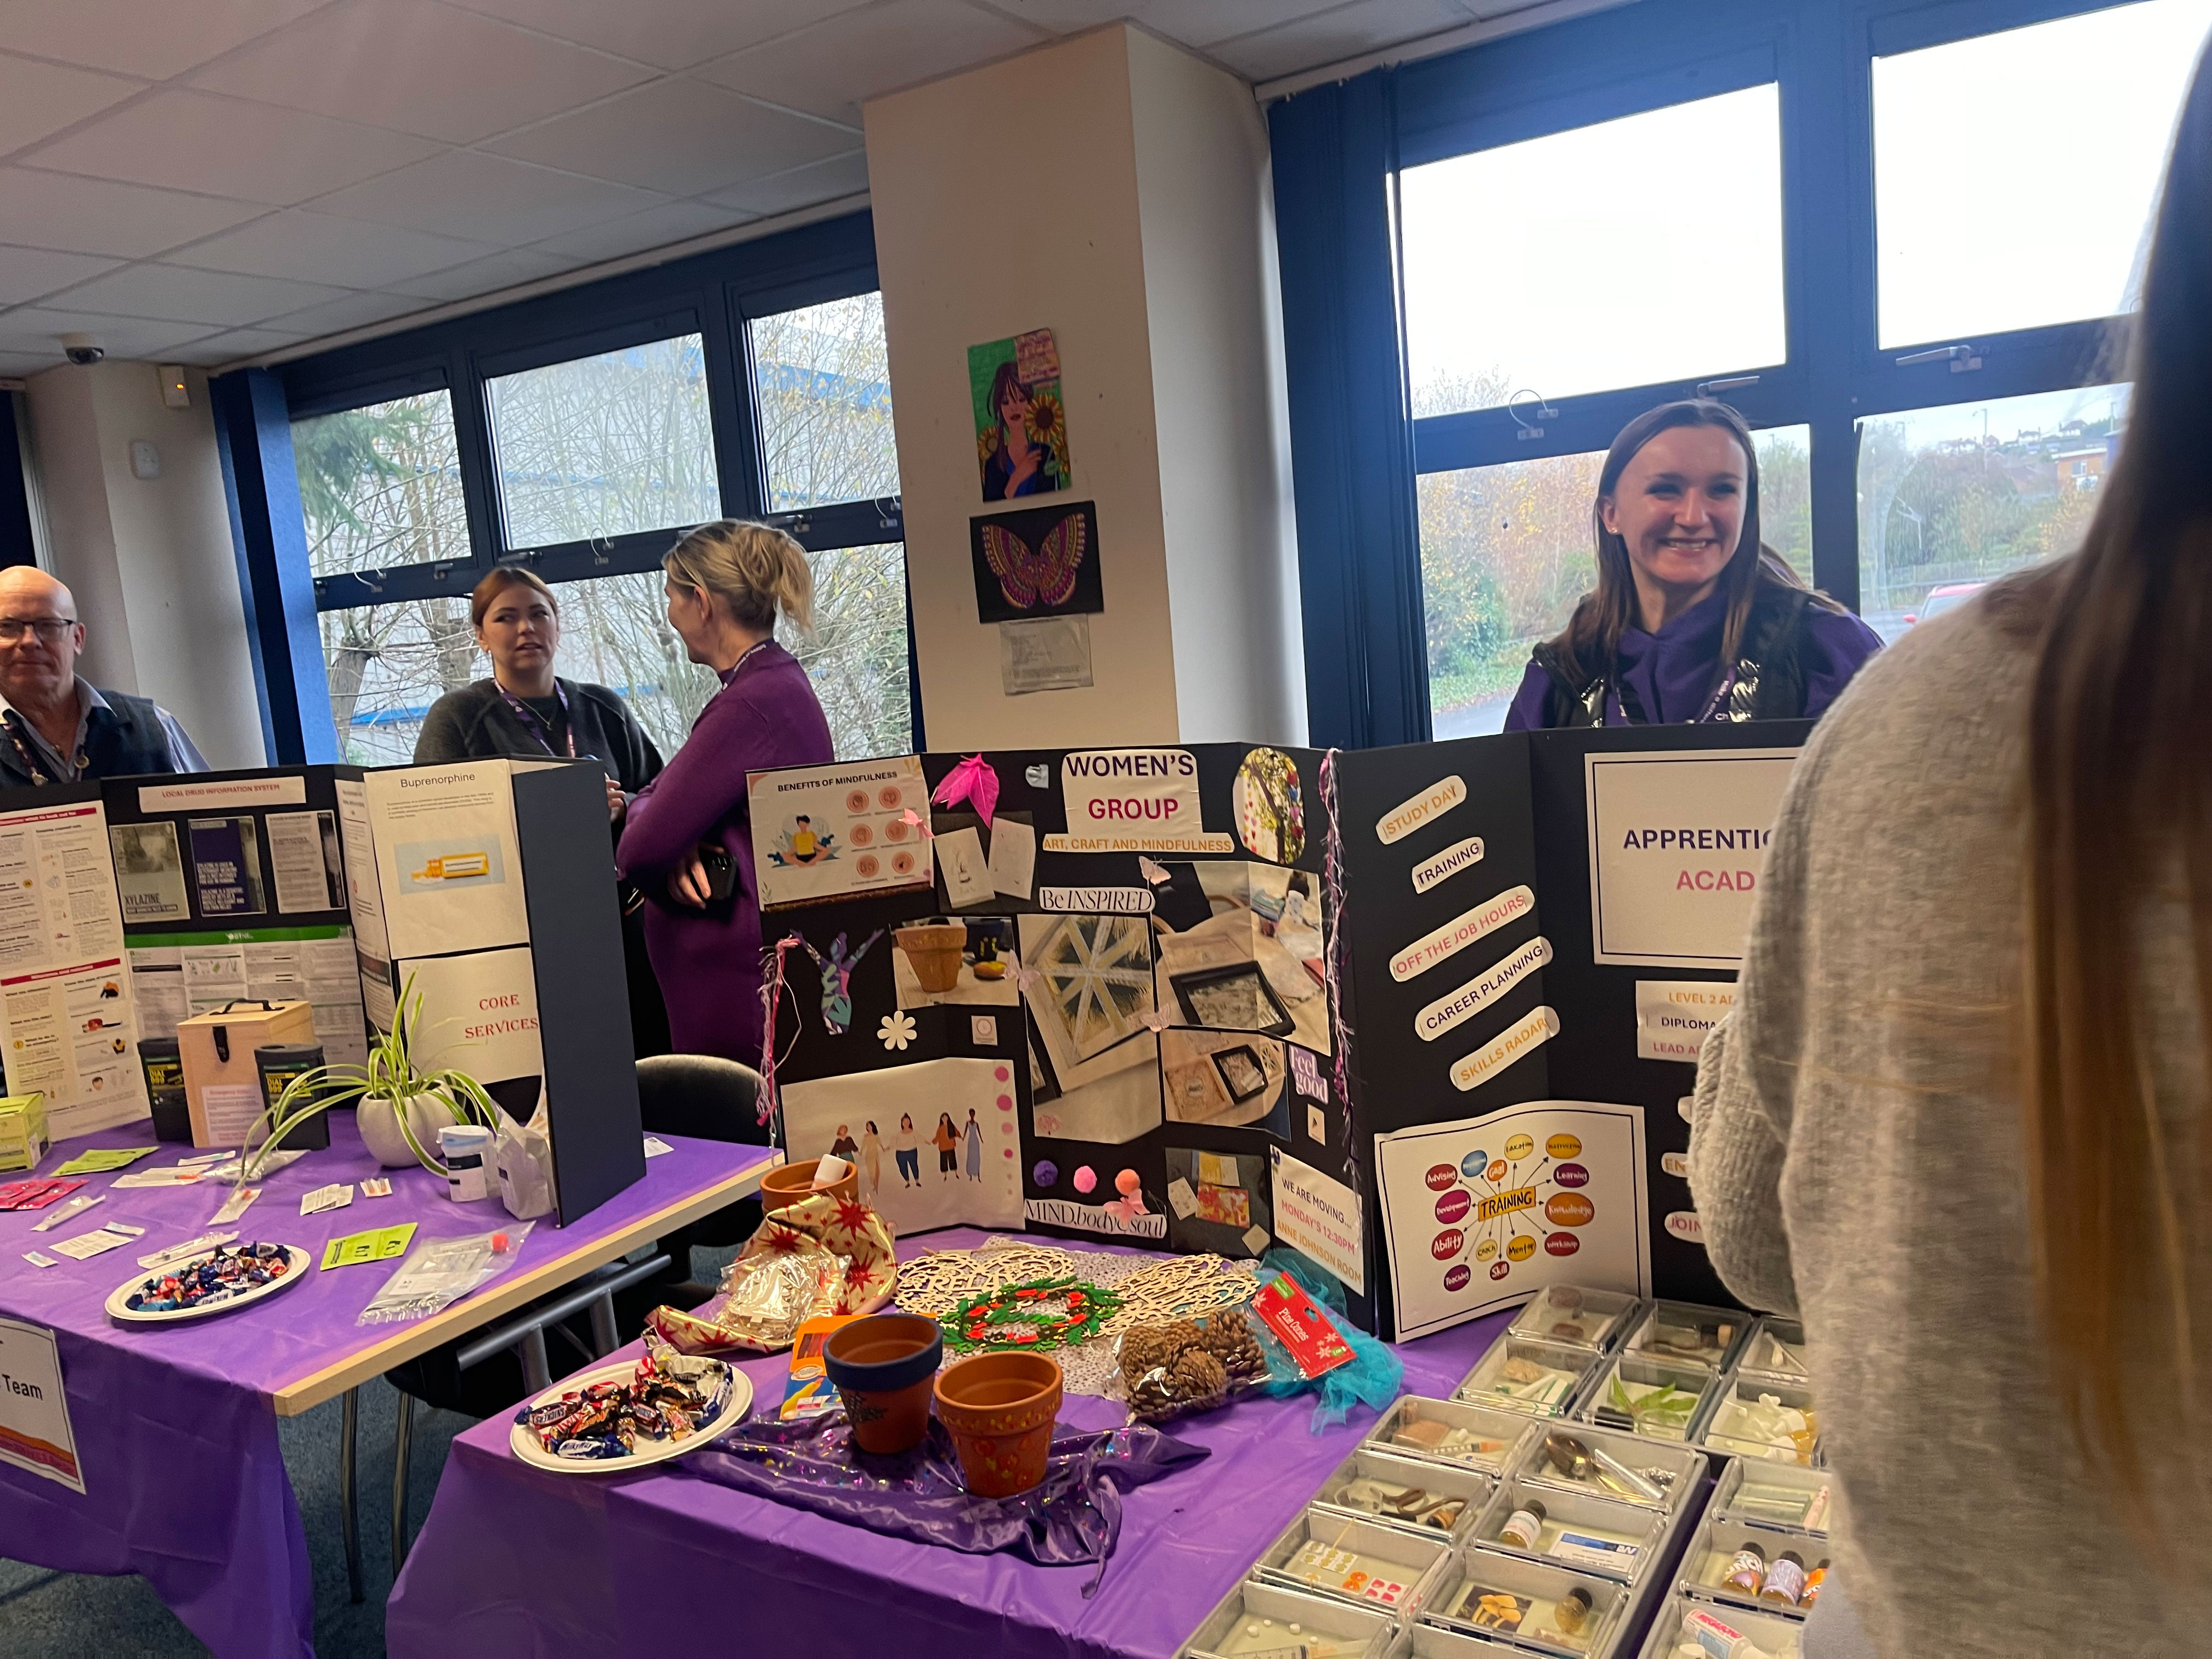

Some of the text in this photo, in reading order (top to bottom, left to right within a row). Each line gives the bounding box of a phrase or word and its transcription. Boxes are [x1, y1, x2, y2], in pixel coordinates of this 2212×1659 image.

[1065, 754, 1194, 777] WOMEN'S
[162, 784, 280, 798] LOCAL DRUG INFORMATION SYSTEM
[400, 773, 475, 788] Buprenorphine
[777, 771, 898, 792] BENEFITS OF MINDFULNESS
[1088, 798, 1178, 820] GROUP
[1386, 785, 1457, 835] STUDY DAY
[1044, 838, 1232, 851] ART, CRAFT AND MINDFULNESS
[1417, 843, 1480, 886] TRAINING
[125, 893, 160, 905] XYLAZINE
[1042, 889, 1152, 911] Be INSPIRED
[1396, 895, 1524, 974] OFF THE JOB HOURS
[1426, 945, 1543, 1029] CAREER PLANNING
[1669, 991, 1706, 1004] LEVEL
[1709, 996, 1716, 1005] 2
[479, 994, 520, 1011] CORE
[465, 1017, 539, 1039] SERVICES
[1661, 1017, 1716, 1030] DIPLOMA
[1460, 1018, 1547, 1082] SKILLS RADAR
[1654, 1042, 1684, 1054] LEAD
[1290, 1045, 1316, 1077] Feel
[1296, 1070, 1328, 1104] good
[1427, 1170, 1456, 1184] Advising
[1488, 1161, 1504, 1178] Goal
[1556, 1170, 1587, 1182] Learning
[1281, 1177, 1352, 1229] WE ARE MOVING...
[1481, 1191, 1532, 1217] TRAINING
[1282, 1200, 1356, 1256] MONDAY'S 12:30PM
[1277, 1219, 1362, 1285] ANNE JOHNSON ROOM
[1433, 1233, 1463, 1254] Ability
[1509, 1242, 1534, 1255] Mentor
[1278, 1307, 1309, 1341] Pine Cones
[2, 1374, 43, 1401] Team
